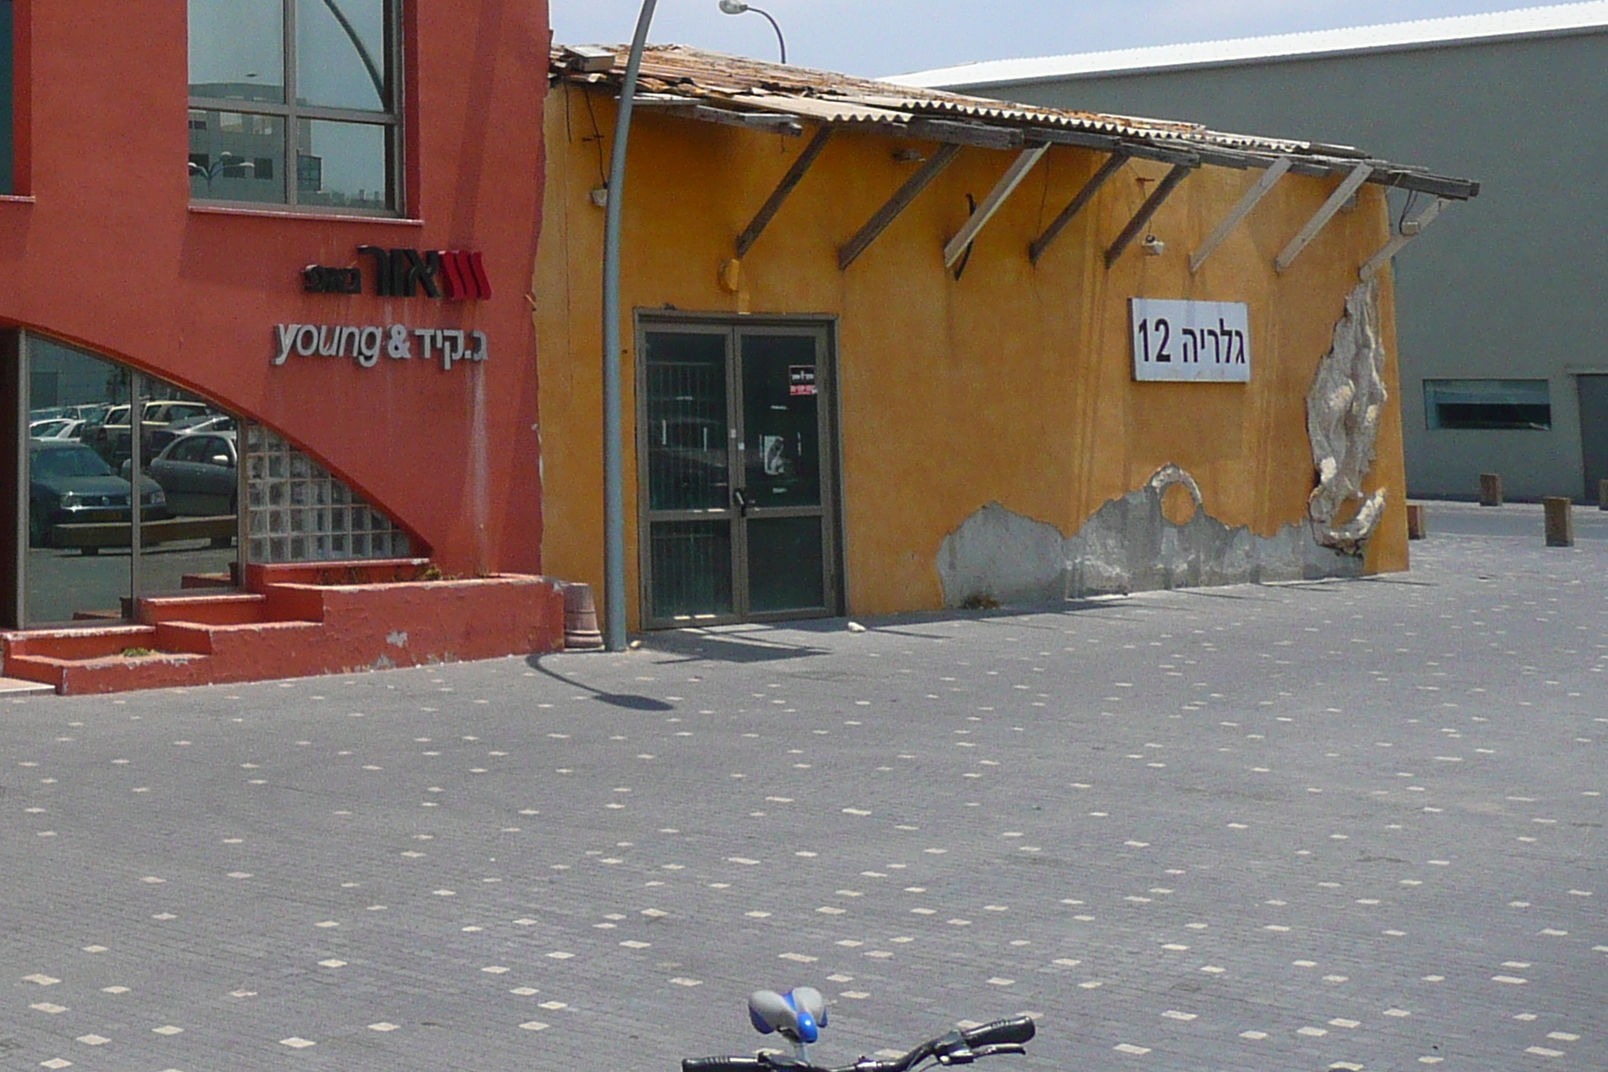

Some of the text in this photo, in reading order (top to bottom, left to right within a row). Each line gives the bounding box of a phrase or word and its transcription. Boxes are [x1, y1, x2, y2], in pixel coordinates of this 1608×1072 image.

[270, 323, 383, 368] young
[1138, 318, 1246, 364] גלריה 12
